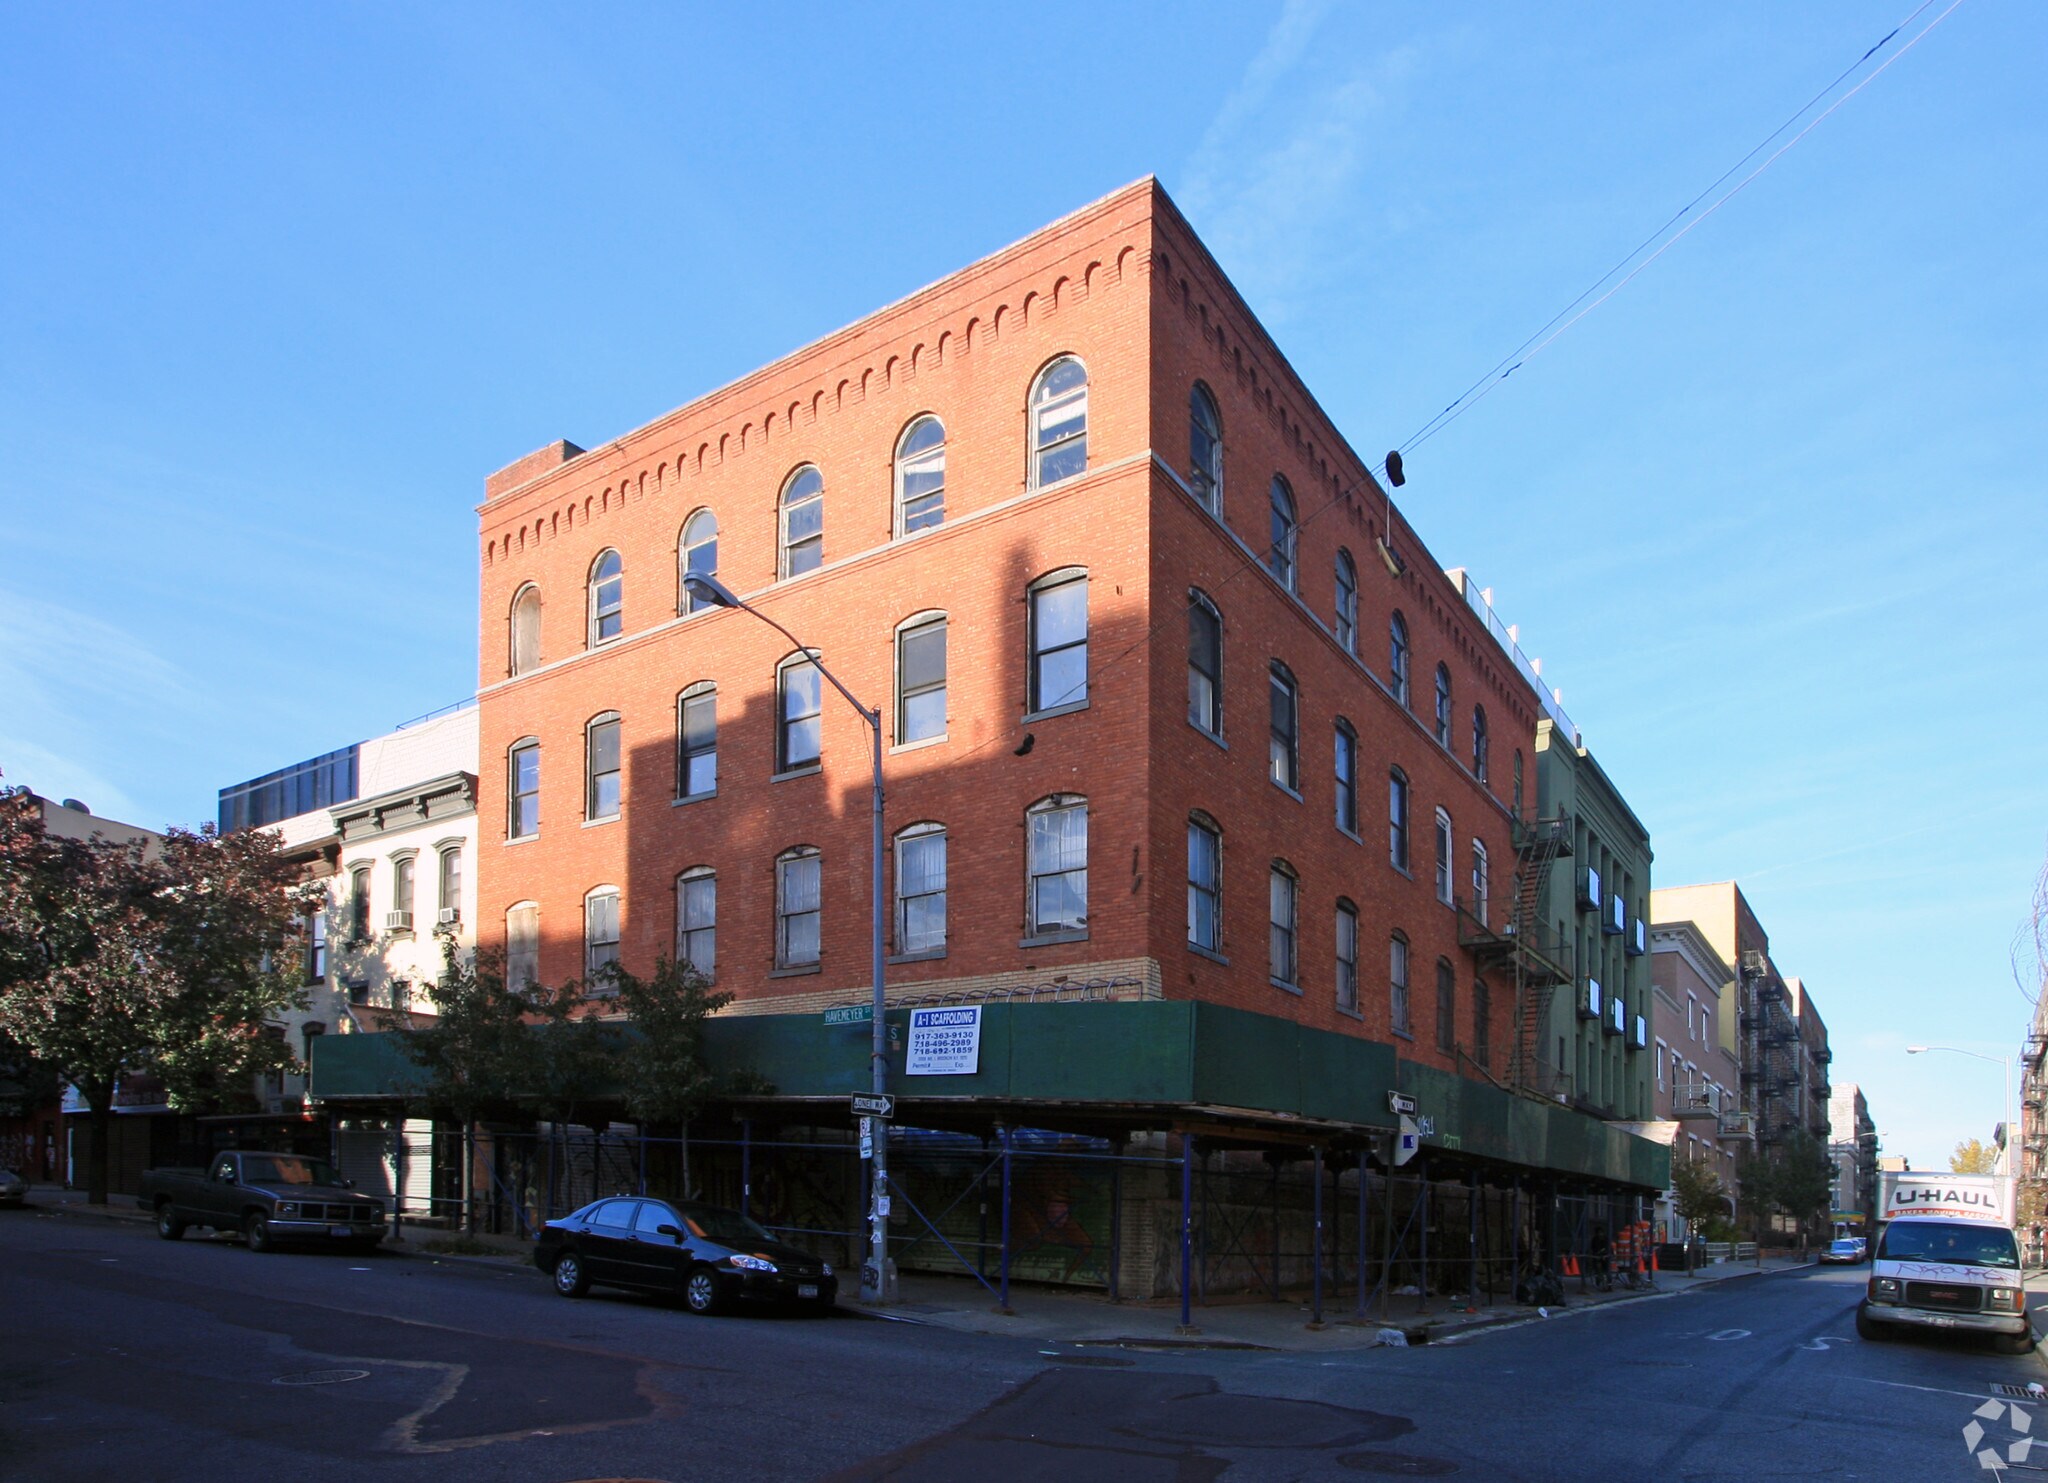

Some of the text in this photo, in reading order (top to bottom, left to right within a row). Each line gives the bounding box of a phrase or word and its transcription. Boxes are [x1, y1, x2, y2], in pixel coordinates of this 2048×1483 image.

[825, 1007, 863, 1023] HAVEMEYER
[930, 1011, 973, 1026] SCAFFOLDING
[915, 1031, 974, 1040] 917-363-9130
[914, 1038, 971, 1048] 718-496-2989
[914, 1046, 973, 1055] 718-692-1859
[858, 1098, 888, 1110] ONE WAY
[1896, 1189, 1995, 1209] U-HAUL
[1894, 1209, 1925, 1218] MAKES
[1926, 1209, 1962, 1217] MOVING
